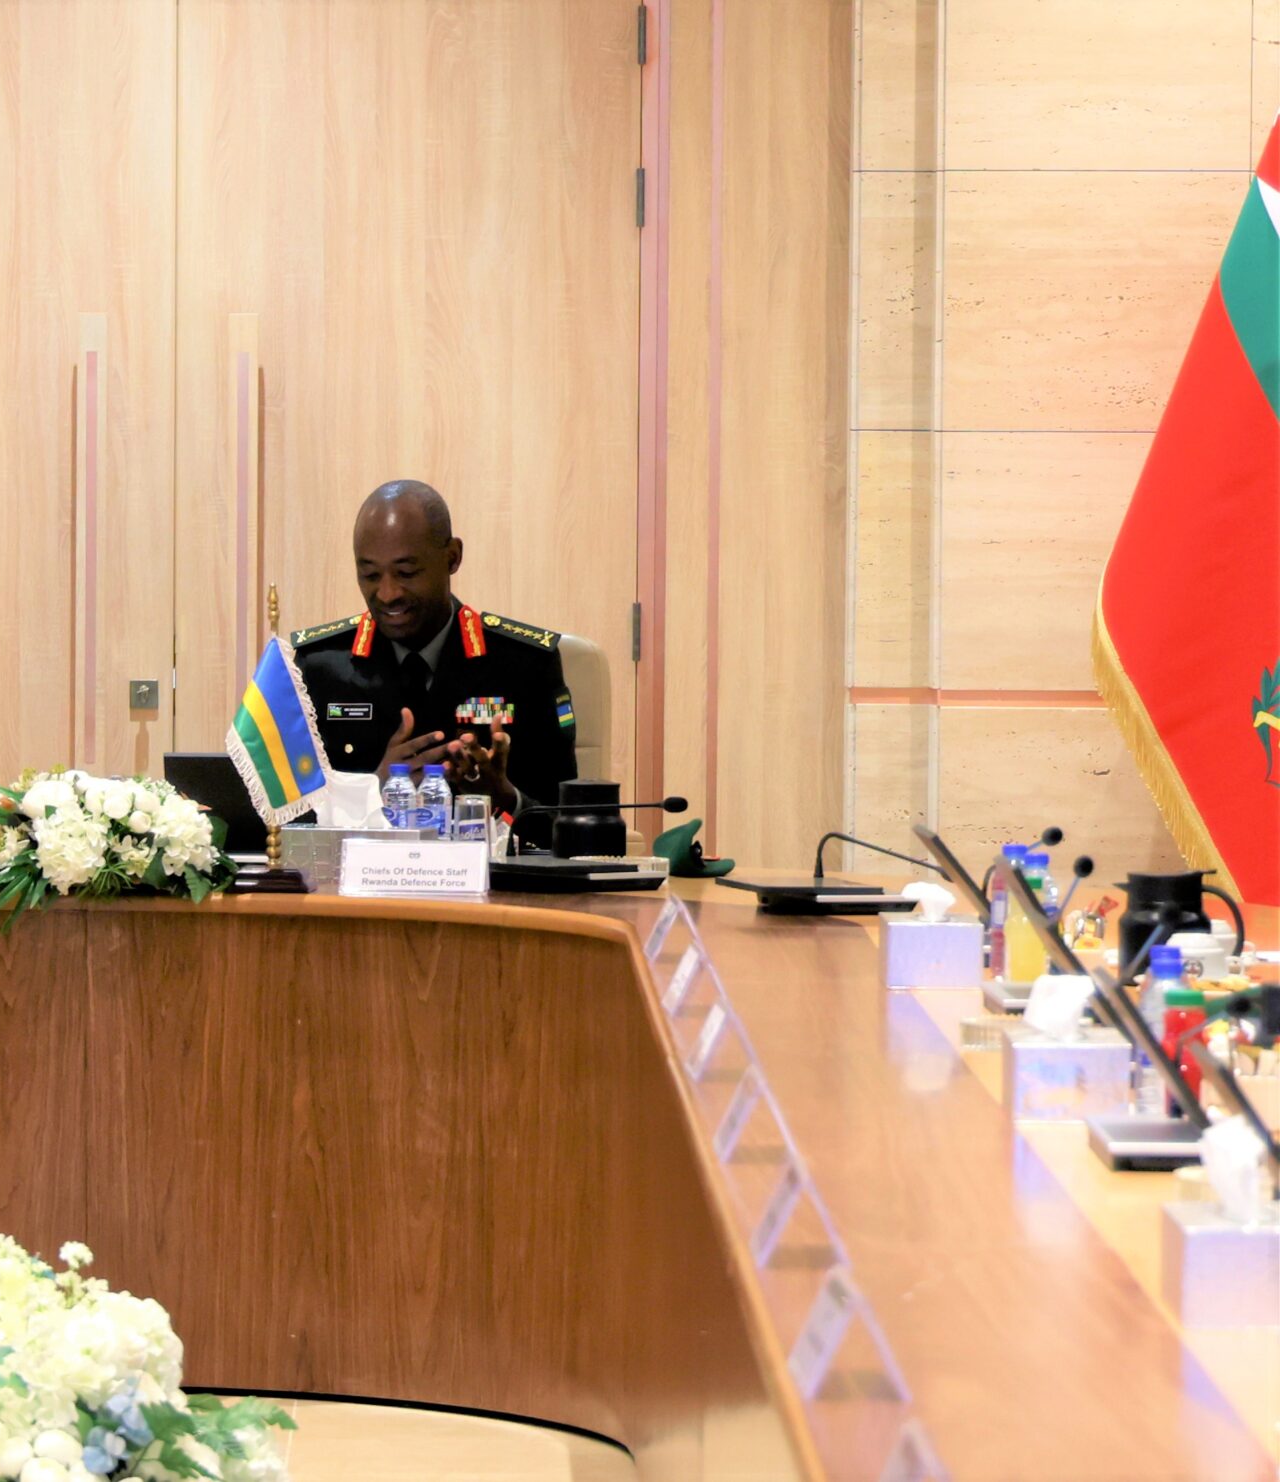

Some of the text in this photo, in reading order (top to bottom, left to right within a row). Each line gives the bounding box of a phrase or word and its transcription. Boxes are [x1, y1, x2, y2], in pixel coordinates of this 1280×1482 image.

[361, 867, 468, 876] Chiefs Of Defence Staff
[361, 877, 466, 887] Rwanda Defence Force
